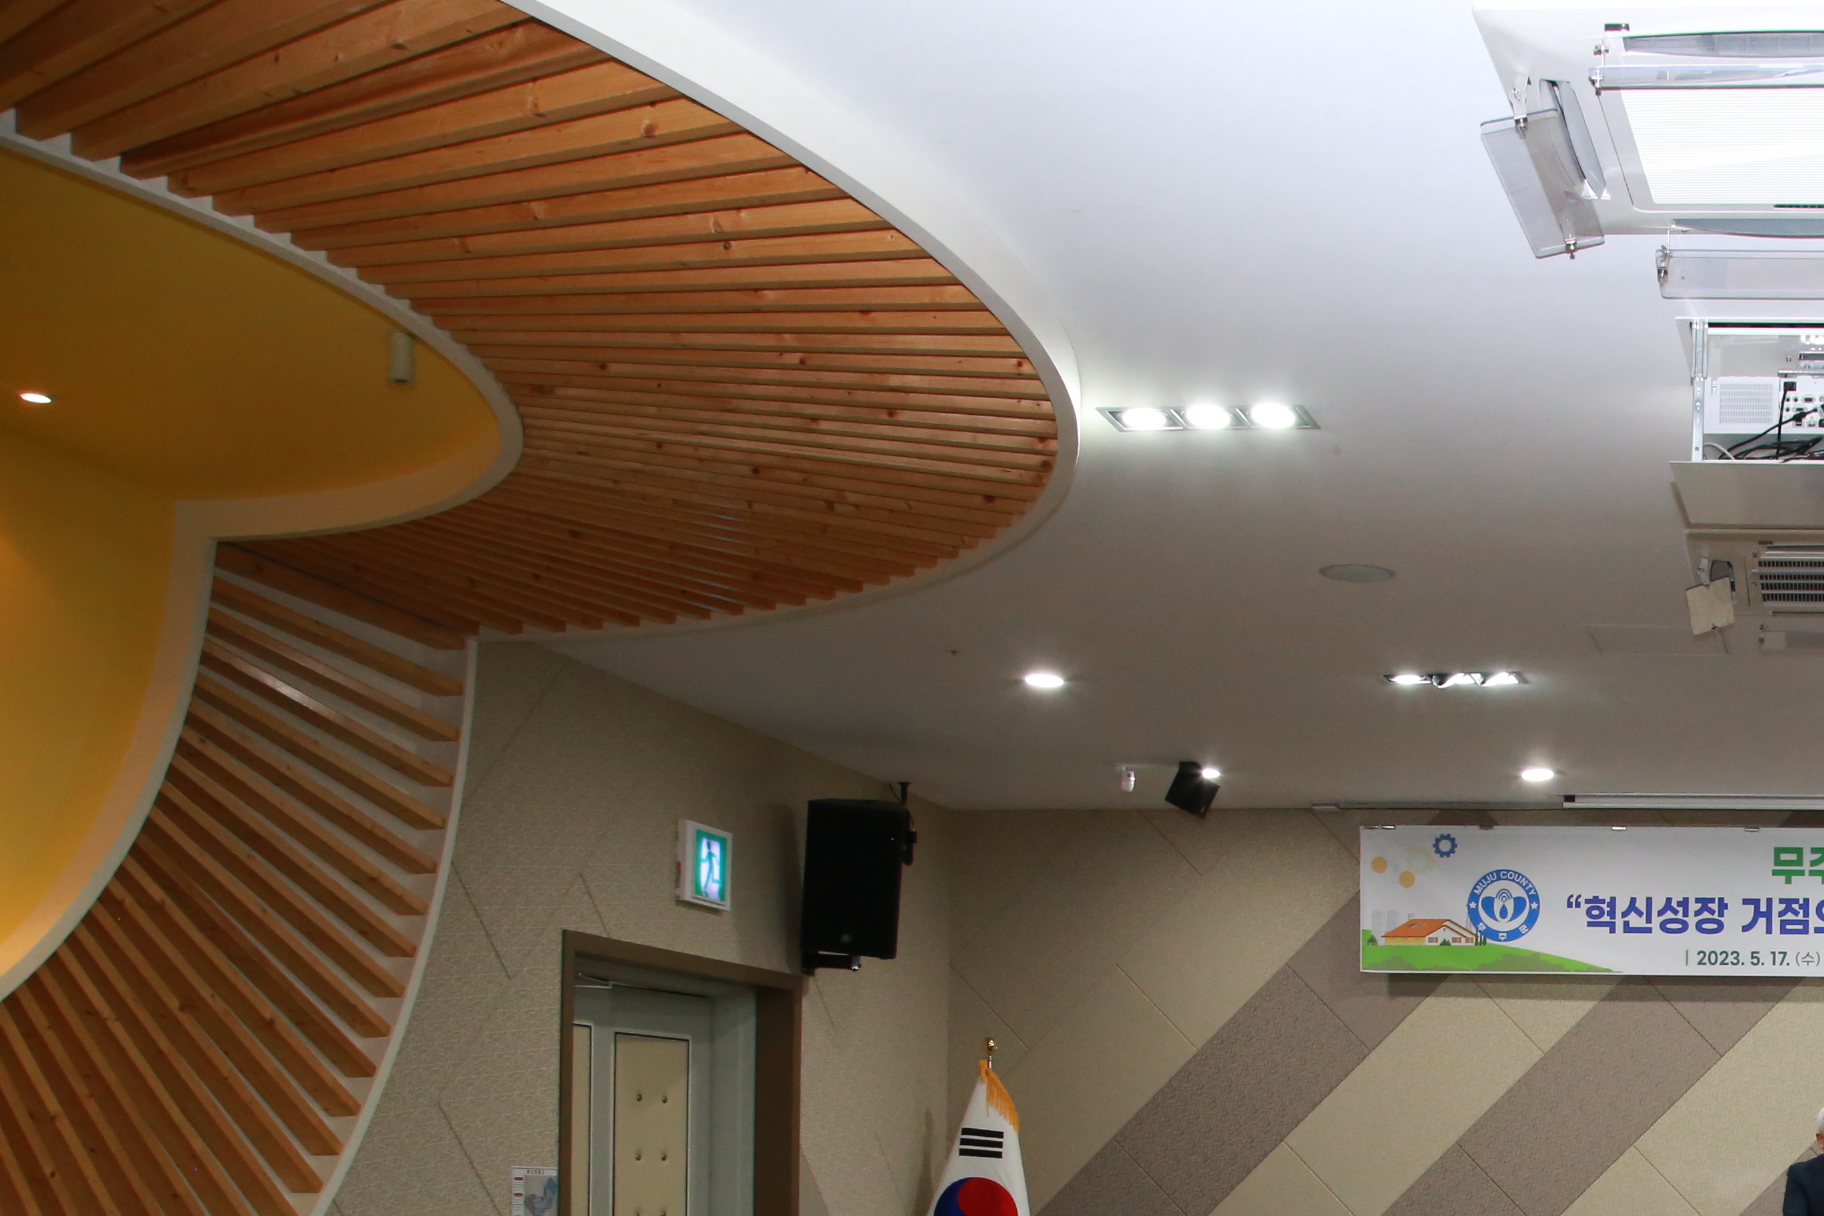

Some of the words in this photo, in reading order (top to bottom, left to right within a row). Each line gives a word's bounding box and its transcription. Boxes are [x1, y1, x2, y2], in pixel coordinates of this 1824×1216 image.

[1473, 872, 1497, 895] MUJU
[1500, 870, 1537, 896] COUNTY
[1566, 893, 1729, 935] “혁신성장
[1696, 950, 1745, 967] 2023.
[1749, 950, 1765, 967] 5.
[1769, 950, 1791, 967] 17.
[1795, 951, 1821, 967] (수)
